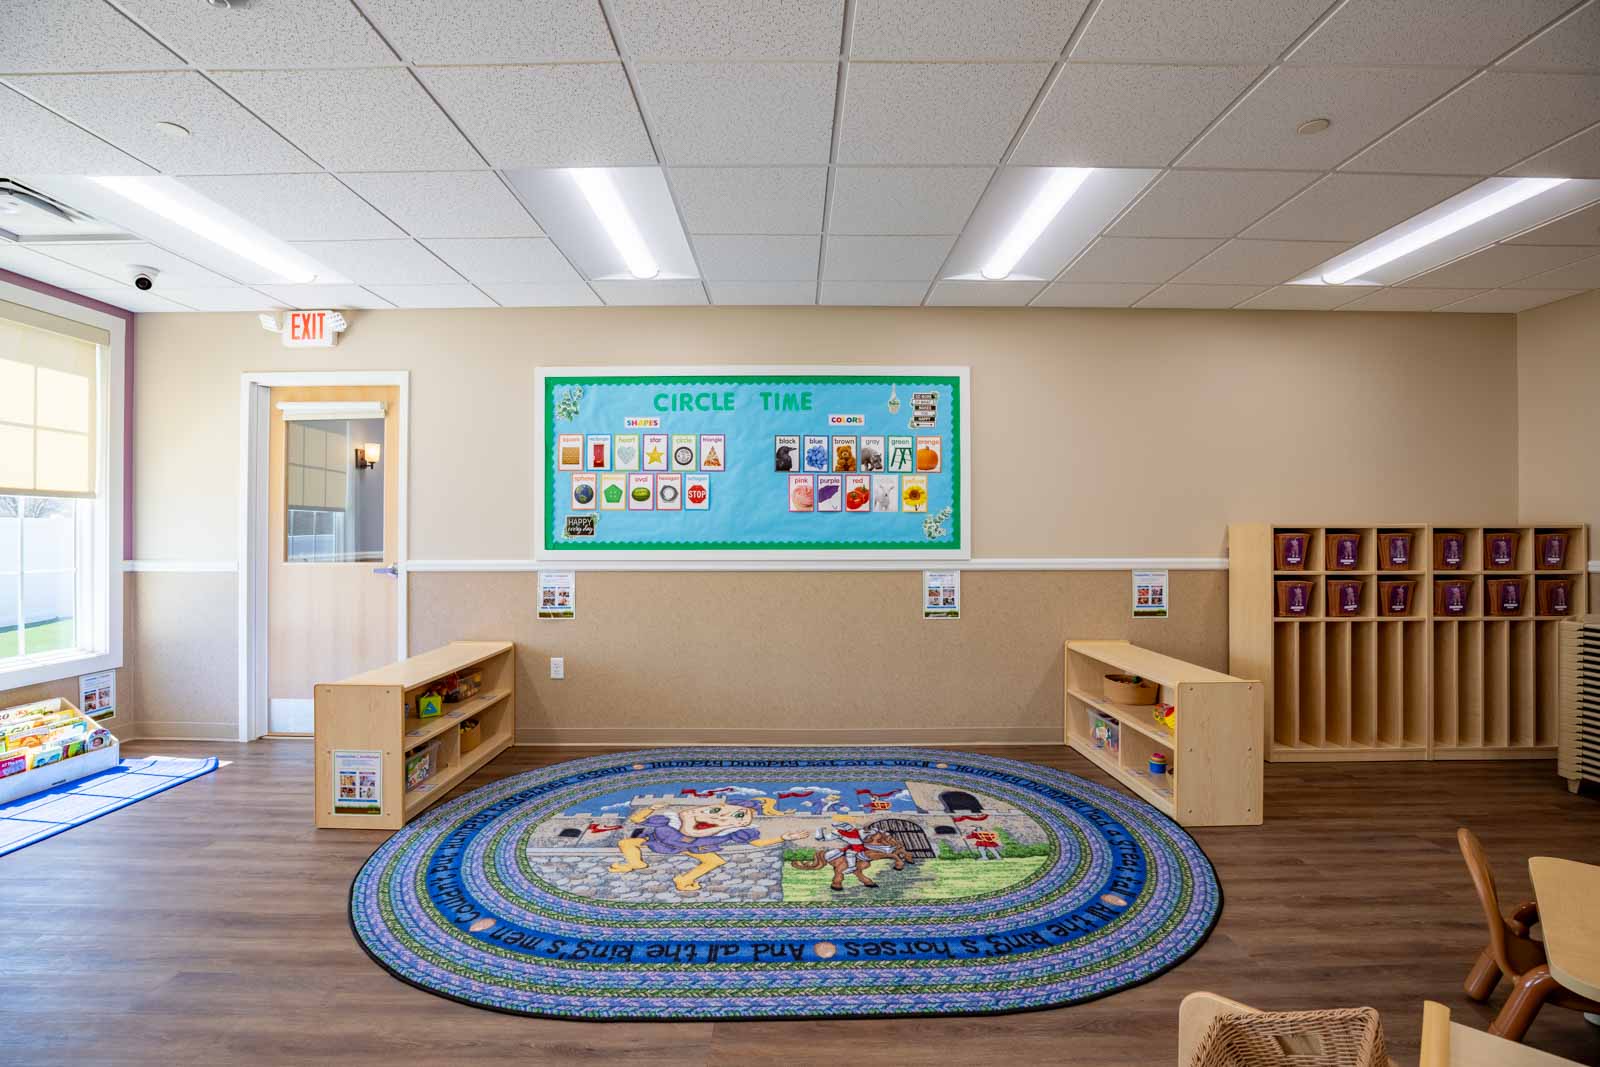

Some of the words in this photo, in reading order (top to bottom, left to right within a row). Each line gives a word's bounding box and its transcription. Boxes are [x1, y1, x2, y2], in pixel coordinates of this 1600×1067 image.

[291, 312, 326, 340] EXIT
[653, 392, 735, 412] CIRCLE
[759, 391, 813, 411] TIME
[626, 419, 659, 427] SHAPES
[831, 416, 863, 424] COLORS
[891, 438, 910, 446] green
[794, 477, 809, 485] pink
[819, 477, 840, 485] purple
[688, 490, 706, 498] STOP
[576, 766, 628, 782] again
[955, 764, 1023, 785] Humpty
[1046, 914, 1092, 938] the
[489, 926, 543, 950] men
[546, 939, 635, 963] king's
[646, 943, 698, 962] the
[707, 943, 741, 963] all
[752, 943, 806, 961] And
[844, 940, 956, 960] horses
